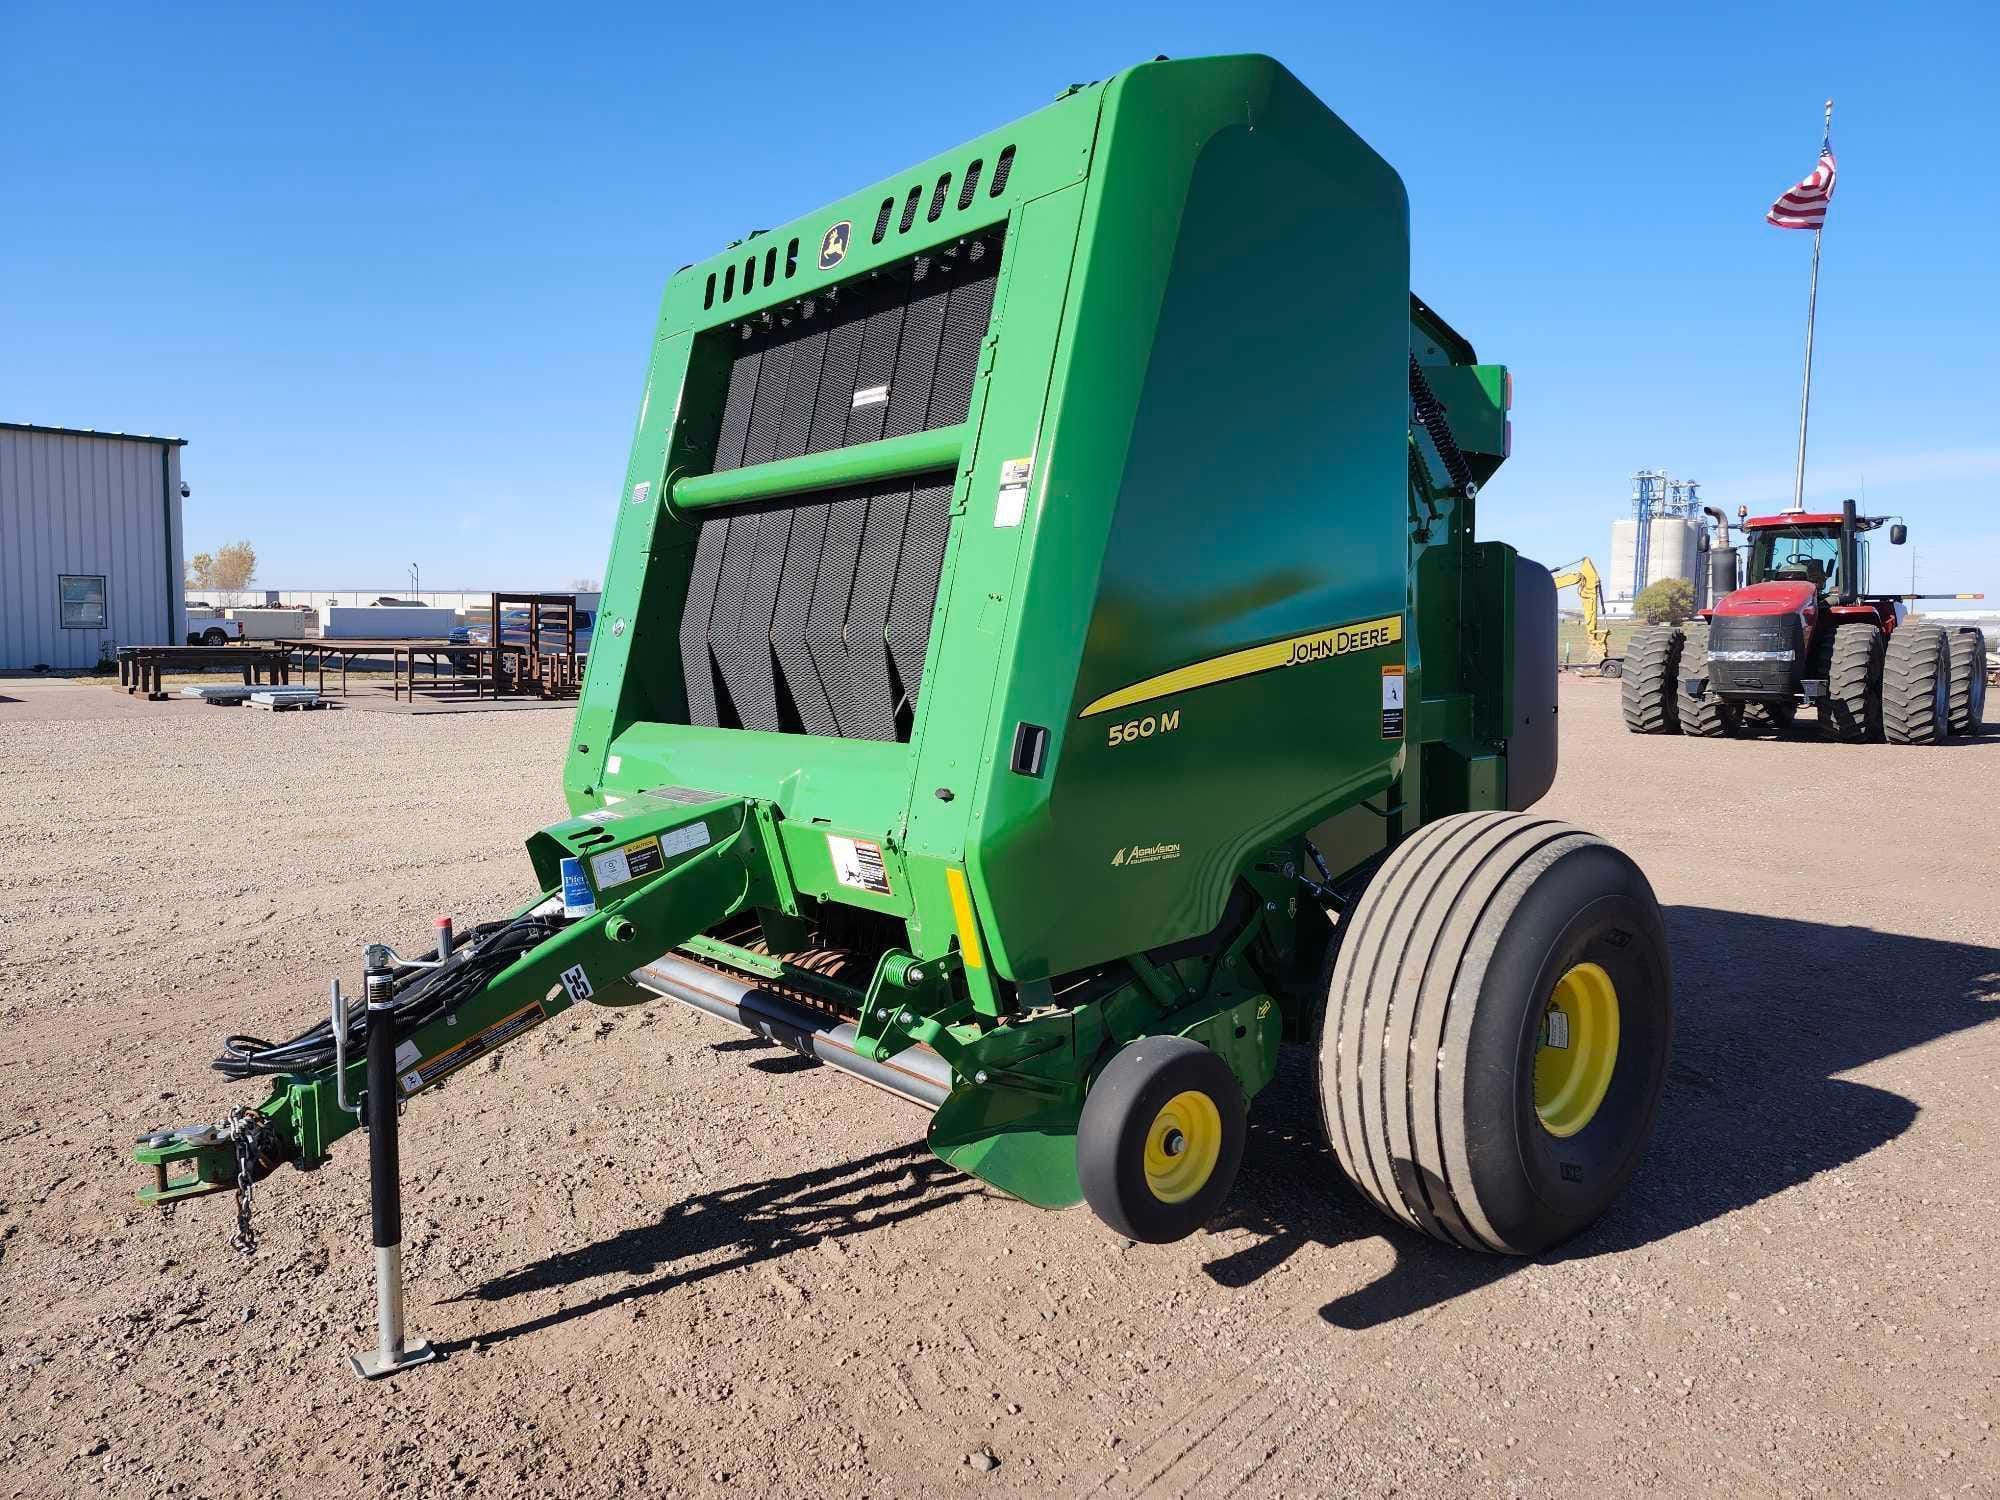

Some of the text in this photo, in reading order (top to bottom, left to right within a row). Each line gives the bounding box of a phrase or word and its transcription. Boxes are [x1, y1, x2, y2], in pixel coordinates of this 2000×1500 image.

[1286, 627, 1389, 664] JOHN DEERE
[1107, 709, 1180, 747] 560 M
